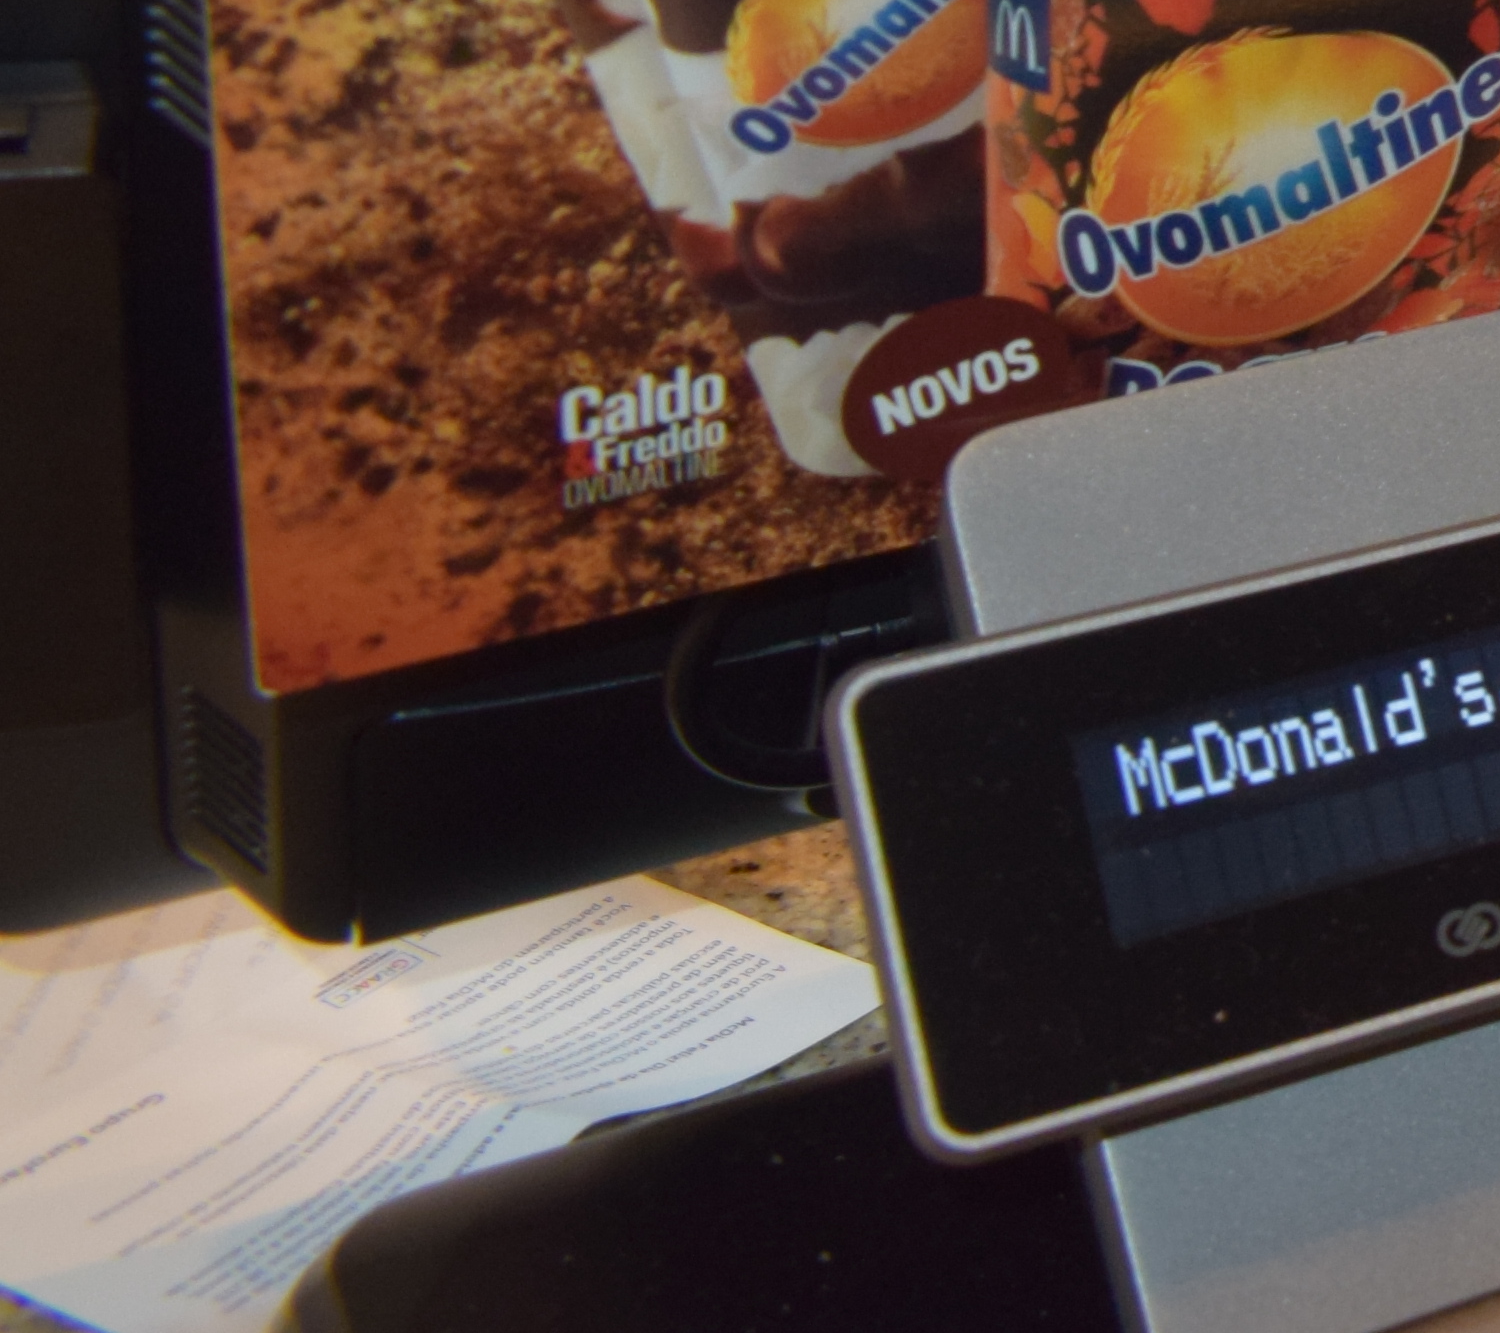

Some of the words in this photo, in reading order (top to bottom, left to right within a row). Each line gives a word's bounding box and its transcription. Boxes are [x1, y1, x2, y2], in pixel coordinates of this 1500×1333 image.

[560, 364, 727, 443] Caldo
[870, 336, 1041, 435] NOVOS
[593, 417, 728, 472] Freddo
[699, 971, 776, 1019] Eurofarma
[705, 1016, 755, 1043] McDia
